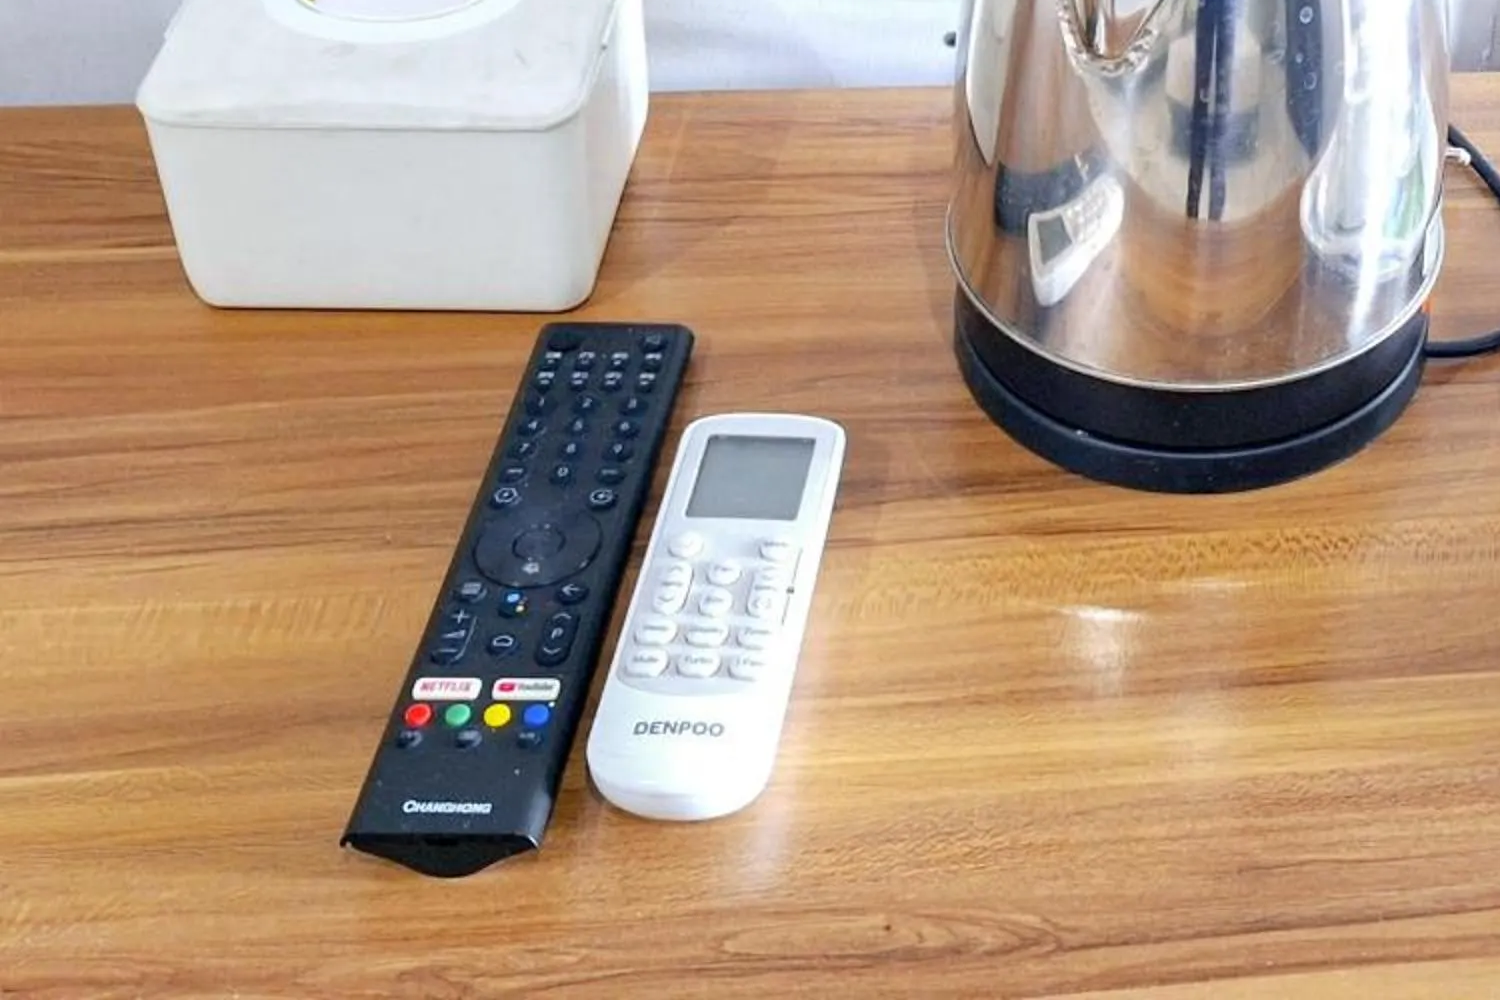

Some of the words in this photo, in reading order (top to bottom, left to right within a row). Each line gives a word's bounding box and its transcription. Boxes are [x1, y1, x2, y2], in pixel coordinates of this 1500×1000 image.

[551, 627, 564, 639] P
[420, 681, 472, 692] NETFLIX
[633, 721, 725, 737] DENPOO
[402, 800, 493, 814] CHANGHONG
